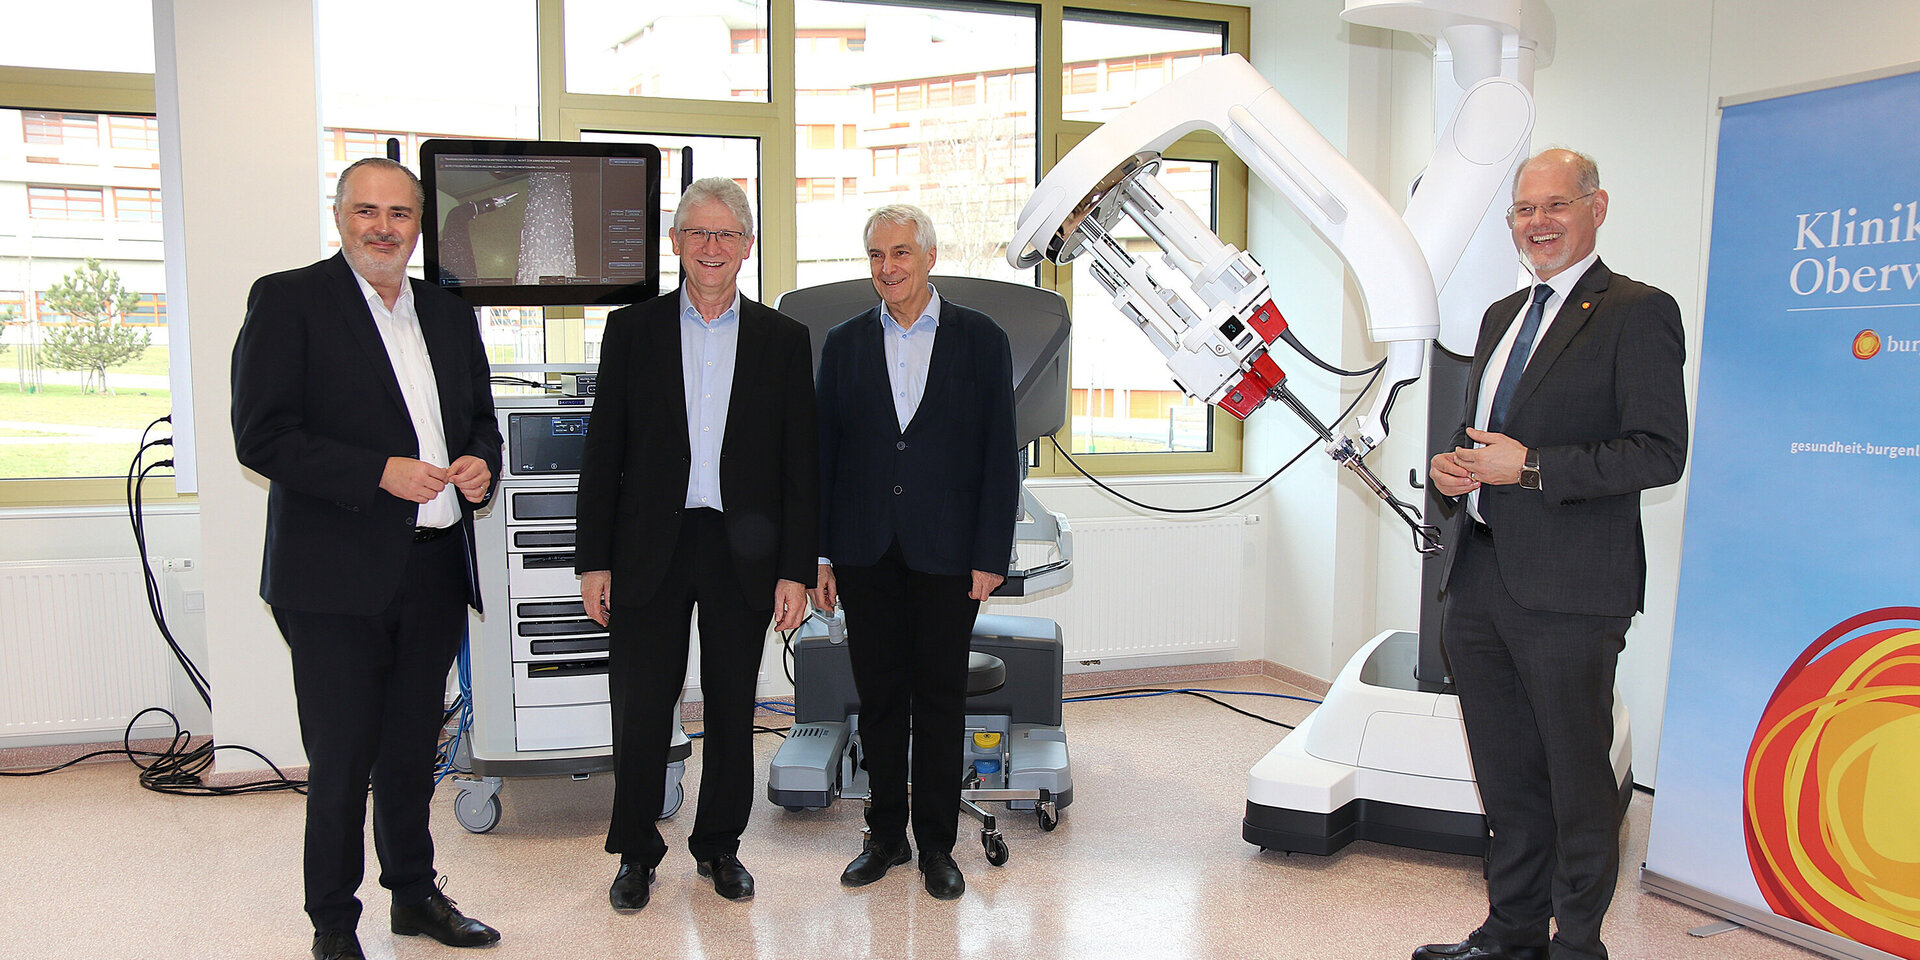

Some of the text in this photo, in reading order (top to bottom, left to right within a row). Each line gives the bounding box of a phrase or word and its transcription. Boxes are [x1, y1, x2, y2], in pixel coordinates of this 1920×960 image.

[1793, 201, 1920, 251] Klinik
[1228, 323, 1237, 333] 3
[1790, 441, 1920, 459] gesundheit-burgenl
